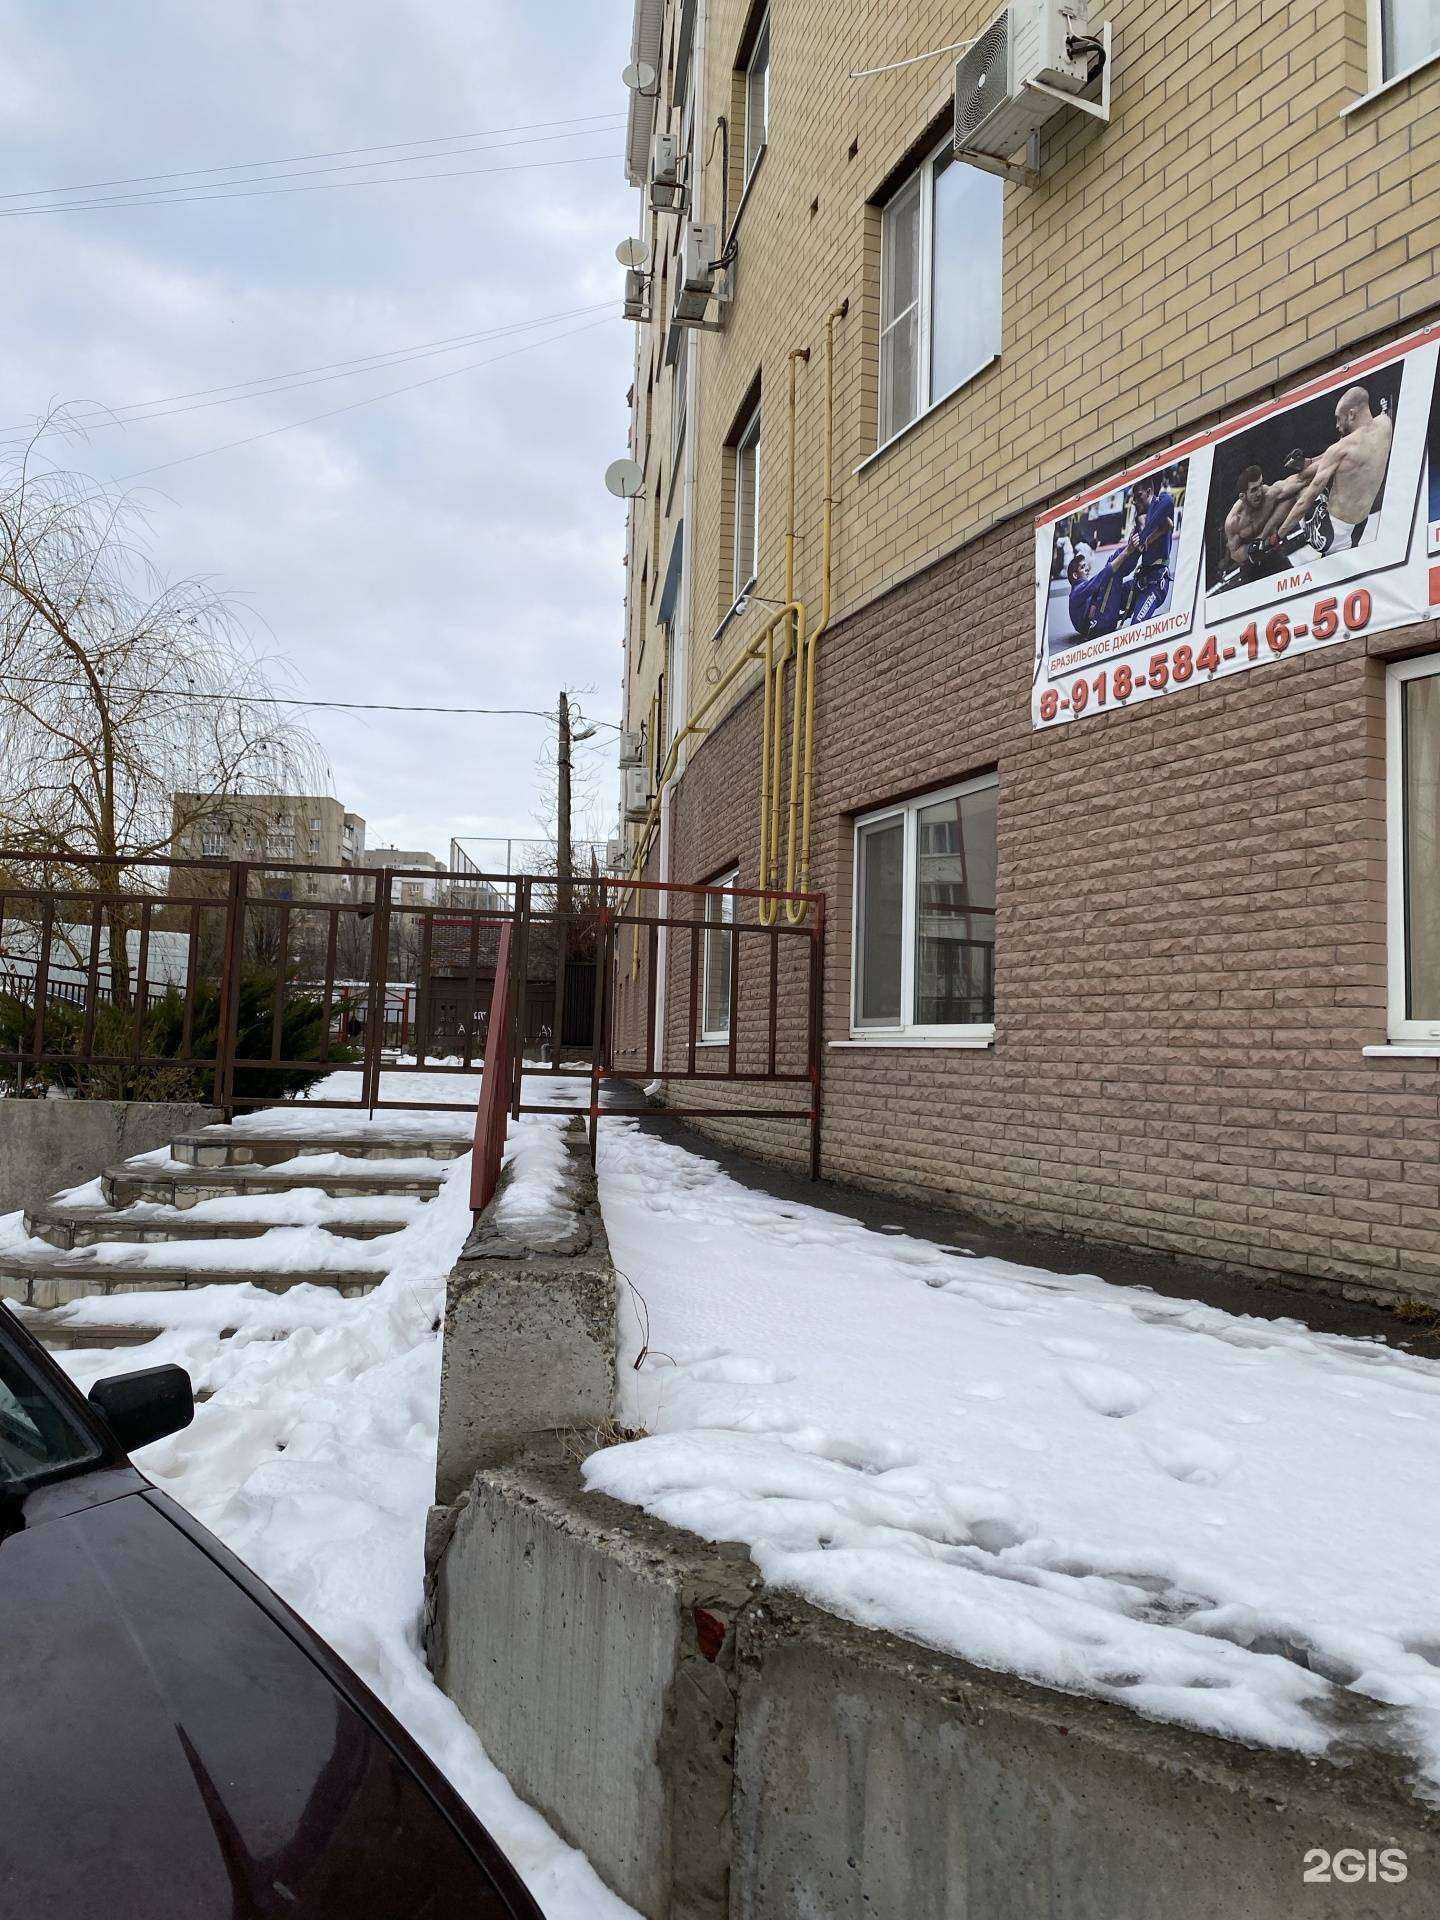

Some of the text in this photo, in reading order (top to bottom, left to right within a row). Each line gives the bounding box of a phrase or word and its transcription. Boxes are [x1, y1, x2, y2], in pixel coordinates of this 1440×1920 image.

[1277, 571, 1313, 592] ММА
[1040, 588, 1372, 721] 8-918-584-16-50
[1050, 612, 1190, 672] БРАЗИЛЬСКОЕ ДЖИУ-ДЖИТСУ
